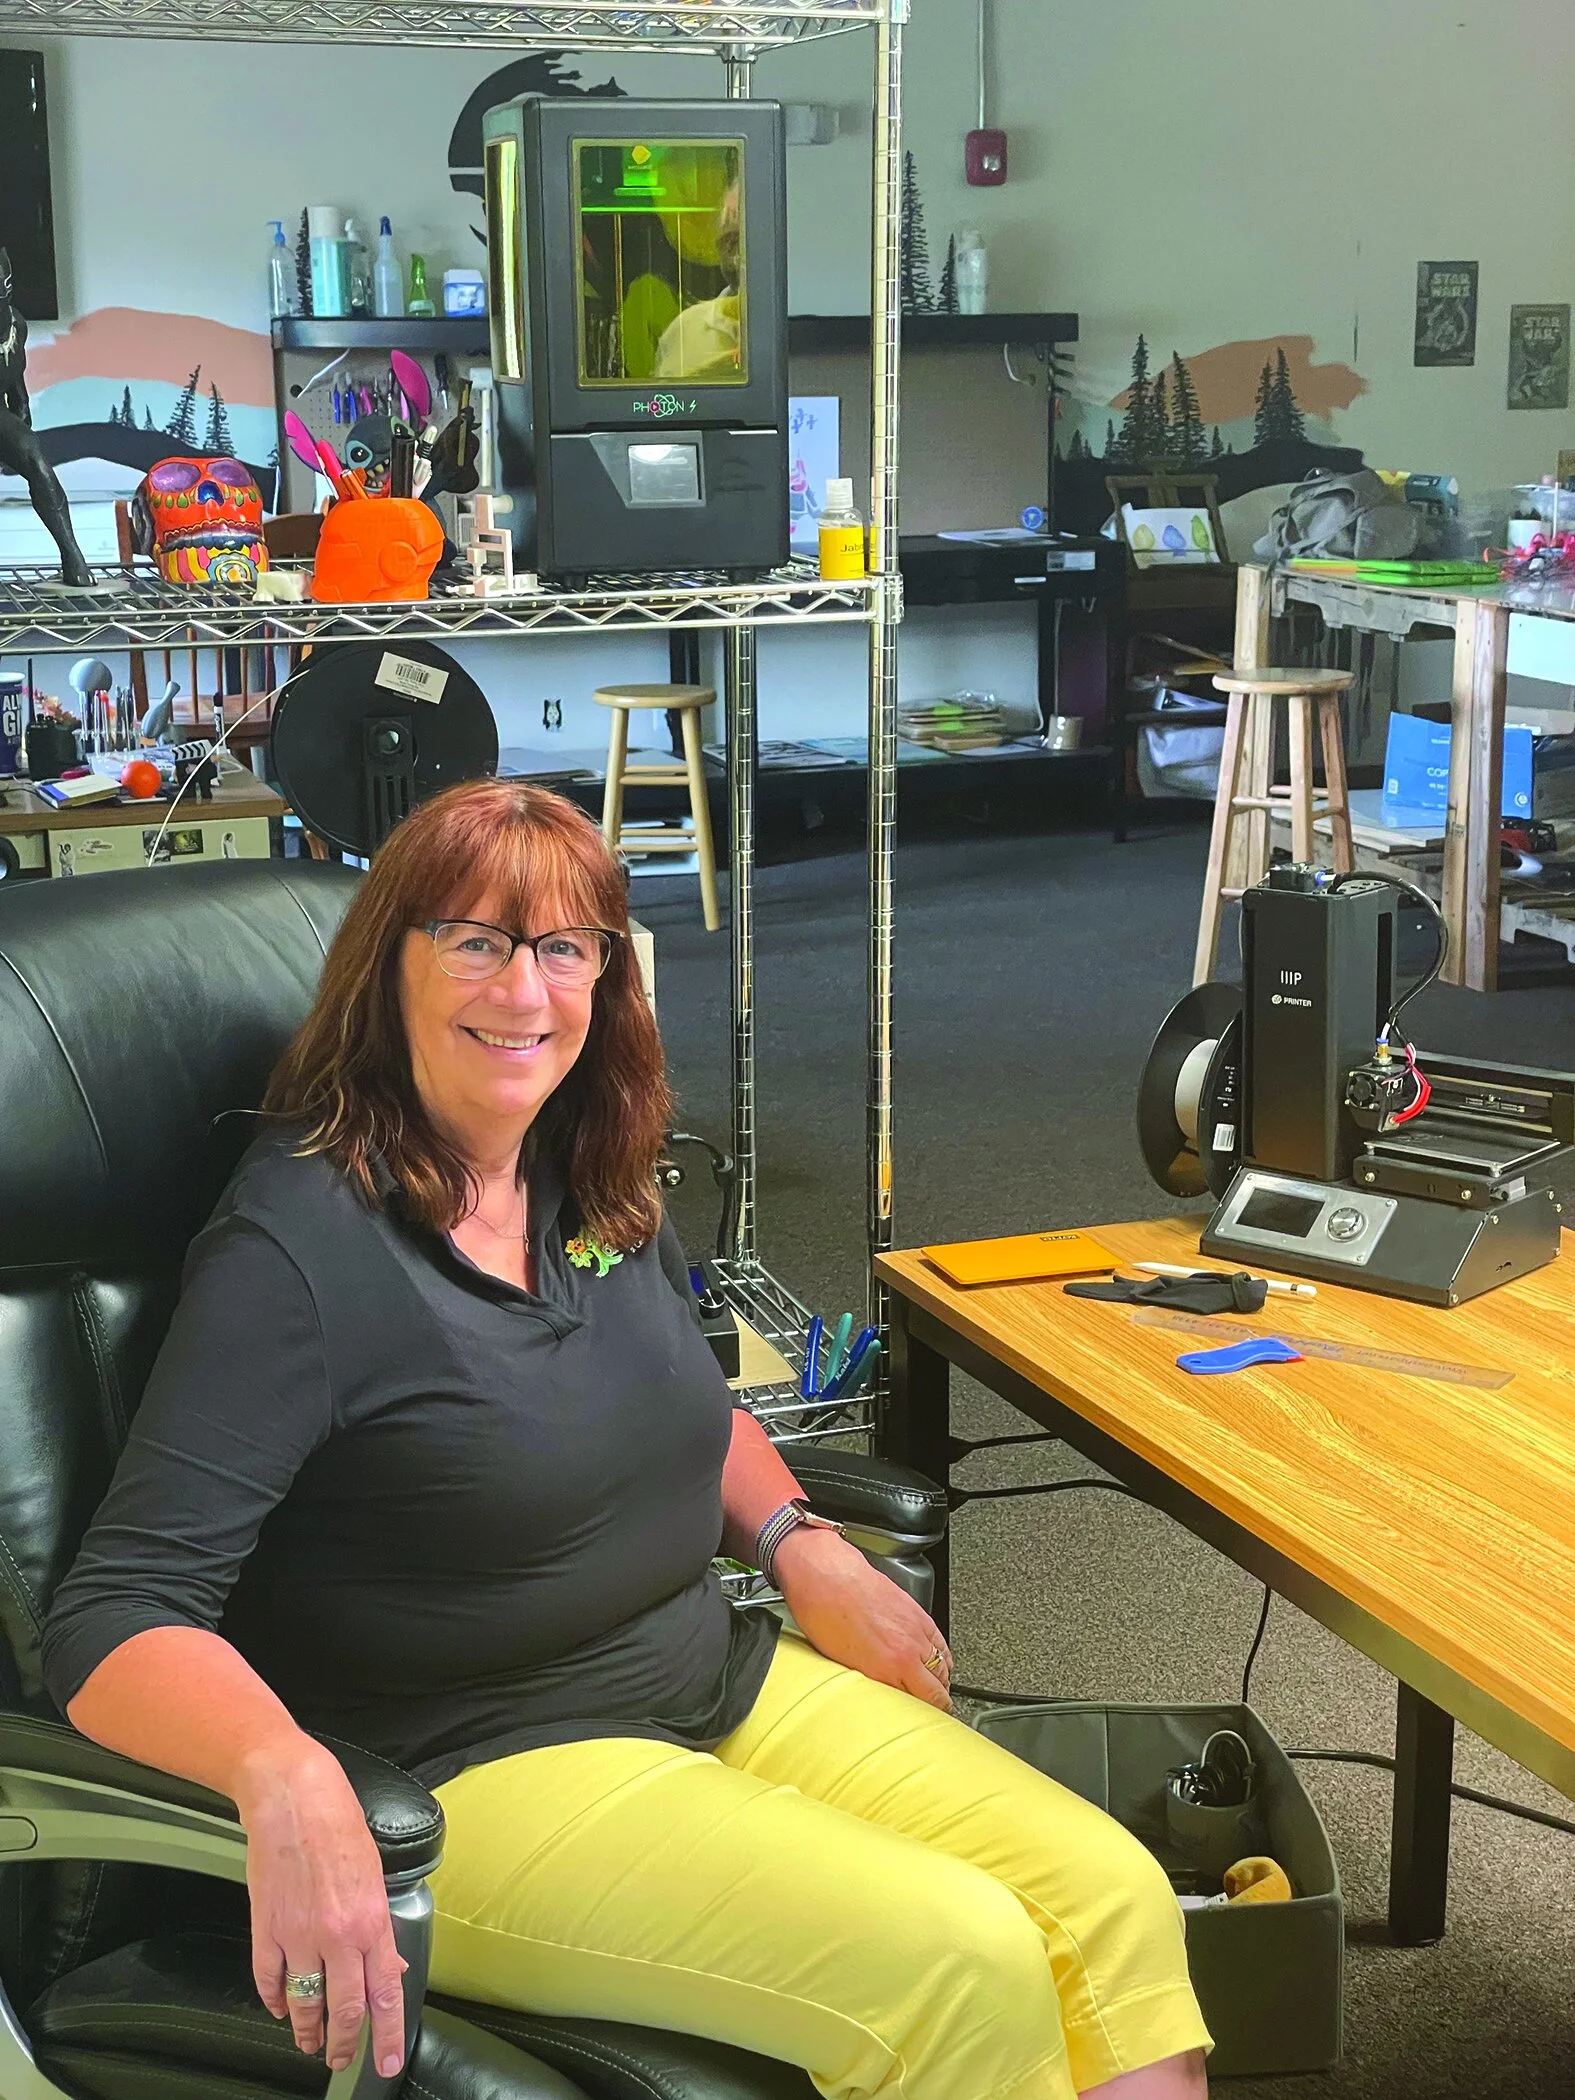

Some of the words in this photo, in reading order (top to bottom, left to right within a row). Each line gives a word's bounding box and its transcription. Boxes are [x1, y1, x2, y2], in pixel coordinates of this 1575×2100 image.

[1433, 273, 1470, 285] STAR
[1522, 317, 1560, 328] STAR
[633, 399, 685, 414] PHOTON
[1283, 996, 1312, 1007] PRINTER
